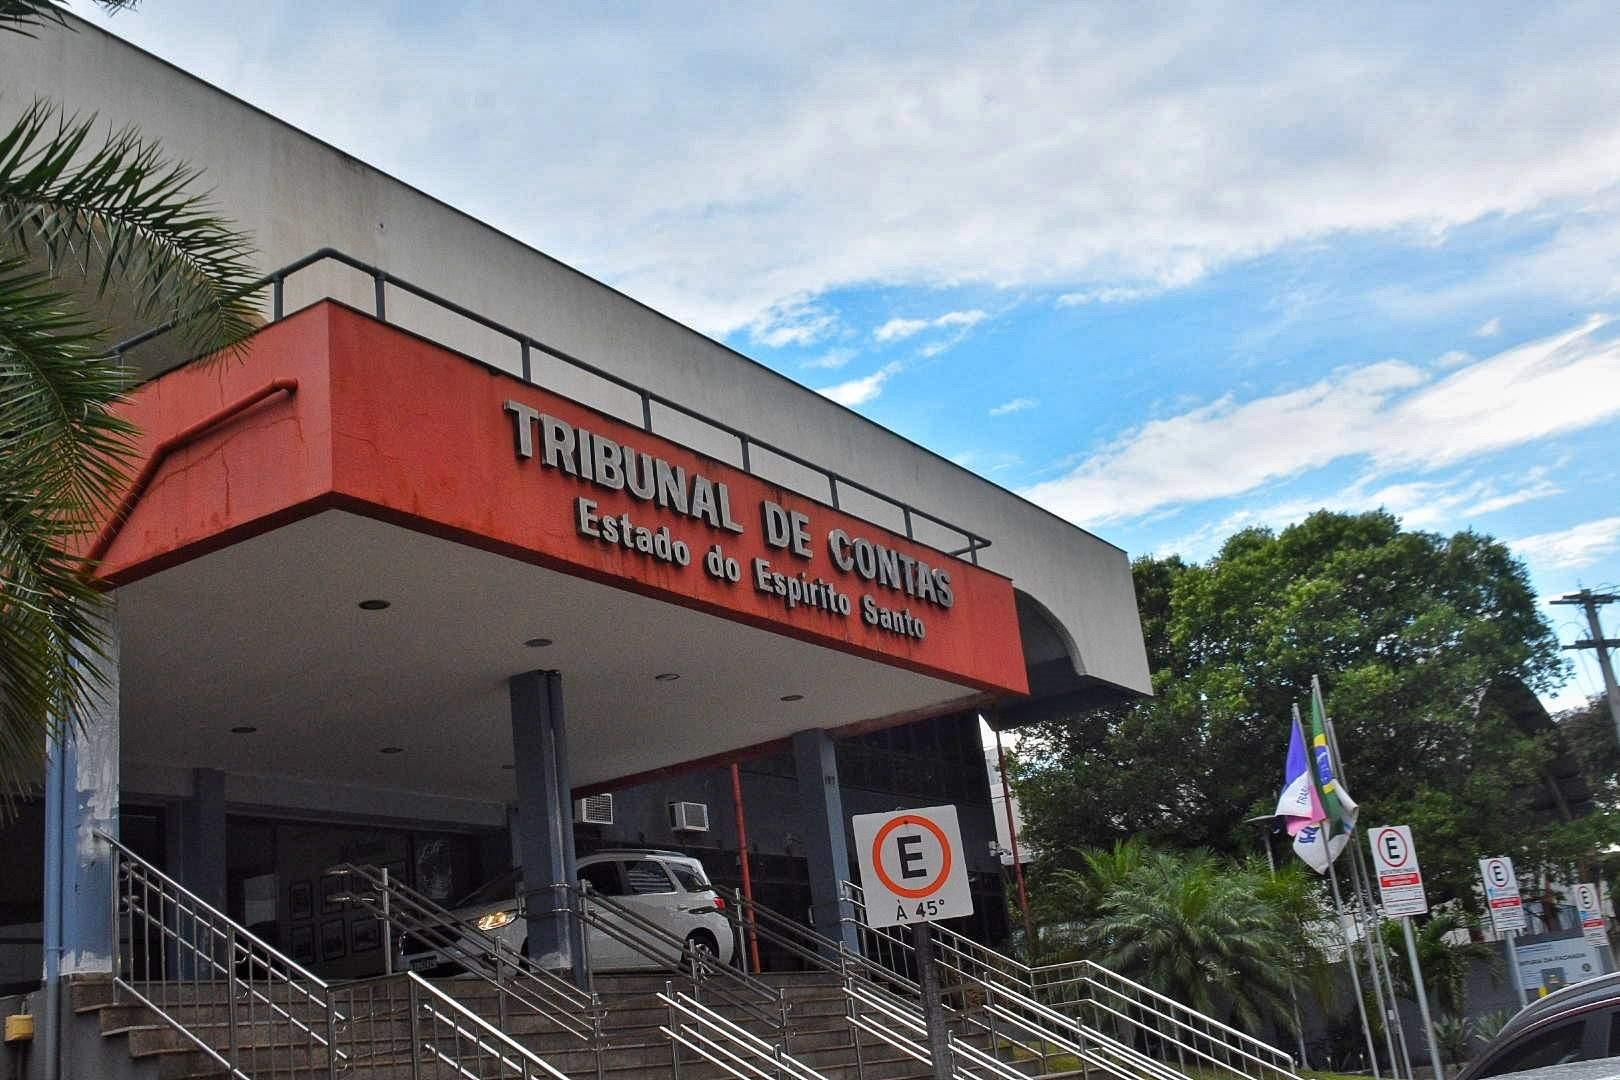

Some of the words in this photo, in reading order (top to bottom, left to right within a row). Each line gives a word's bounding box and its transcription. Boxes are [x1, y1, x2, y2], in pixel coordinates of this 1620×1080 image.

[503, 399, 744, 534] TRIBUNAL
[761, 500, 813, 560] DE
[827, 528, 954, 609] CONTAS
[575, 496, 691, 568] Estado
[704, 545, 741, 583] do
[861, 594, 926, 640] Santo
[896, 835, 927, 879] E
[1385, 837, 1401, 859] E
[1493, 866, 1504, 881] E
[915, 899, 945, 917] 45°
